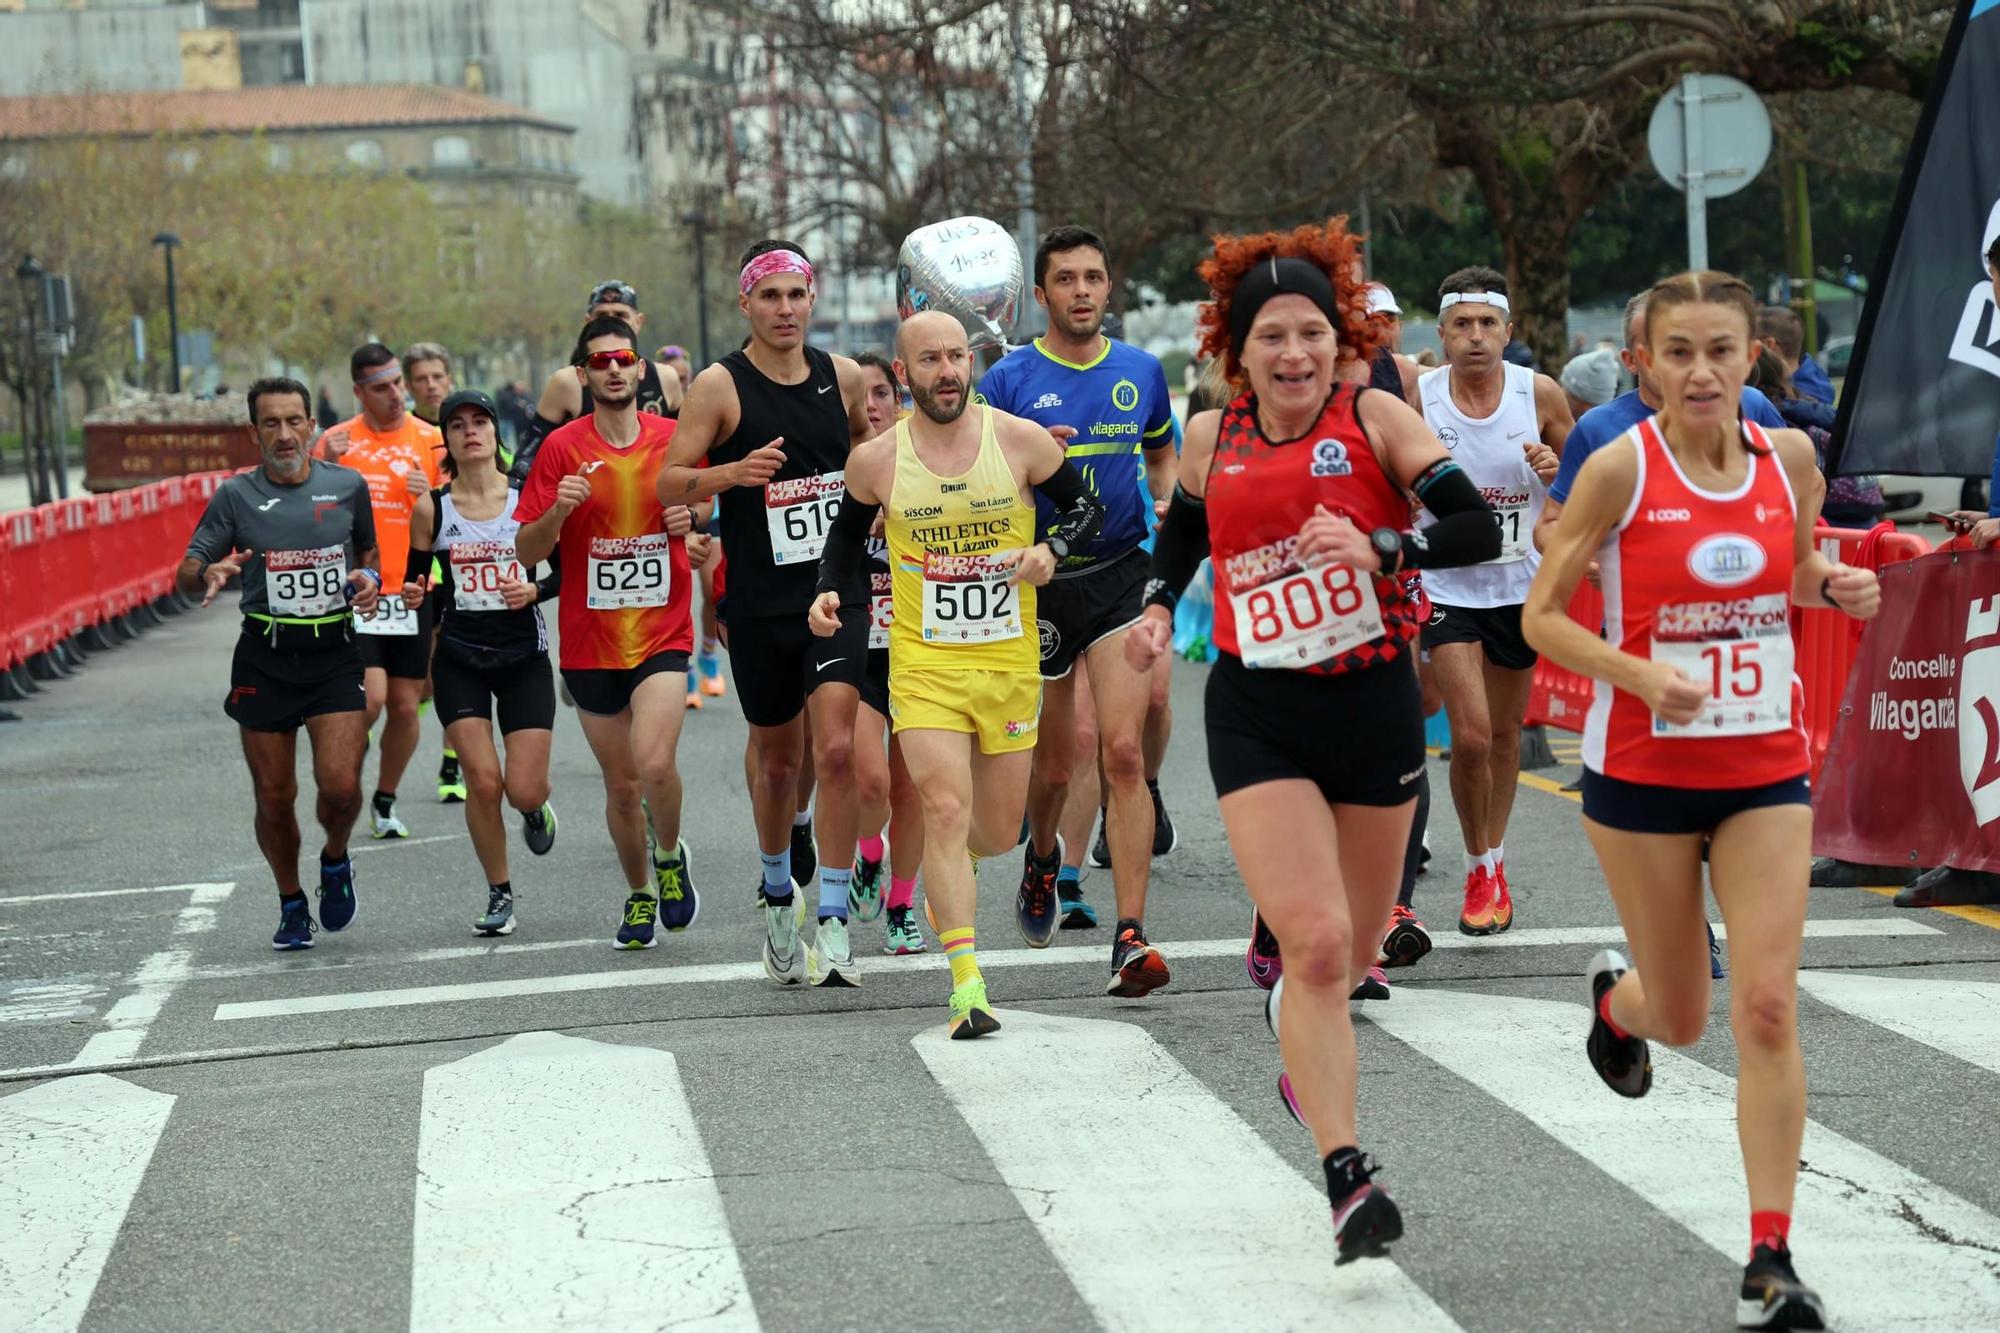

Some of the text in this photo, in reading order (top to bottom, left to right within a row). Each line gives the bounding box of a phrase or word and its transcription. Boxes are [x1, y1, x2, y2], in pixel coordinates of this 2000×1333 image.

[1089, 421, 1139, 437] vilagarcía
[1313, 462, 1349, 474] can
[767, 475, 824, 492] MEDIO
[970, 496, 1013, 509] San Lázaro
[911, 518, 1010, 543] ATHLETICS
[452, 541, 502, 551] MEDIO
[591, 541, 667, 555] MARATÓN
[592, 536, 641, 546] MEDIO
[925, 538, 999, 556] San Lázaro
[270, 549, 321, 561] MEDIO
[928, 554, 991, 567] MEDIO
[597, 558, 662, 590] 629
[276, 568, 341, 599] 398
[936, 580, 1011, 620] 502
[1247, 563, 1363, 643] 808
[1657, 599, 1753, 617] MEDIO
[1656, 609, 1786, 634] MARATÓN
[1701, 642, 1762, 699] 15
